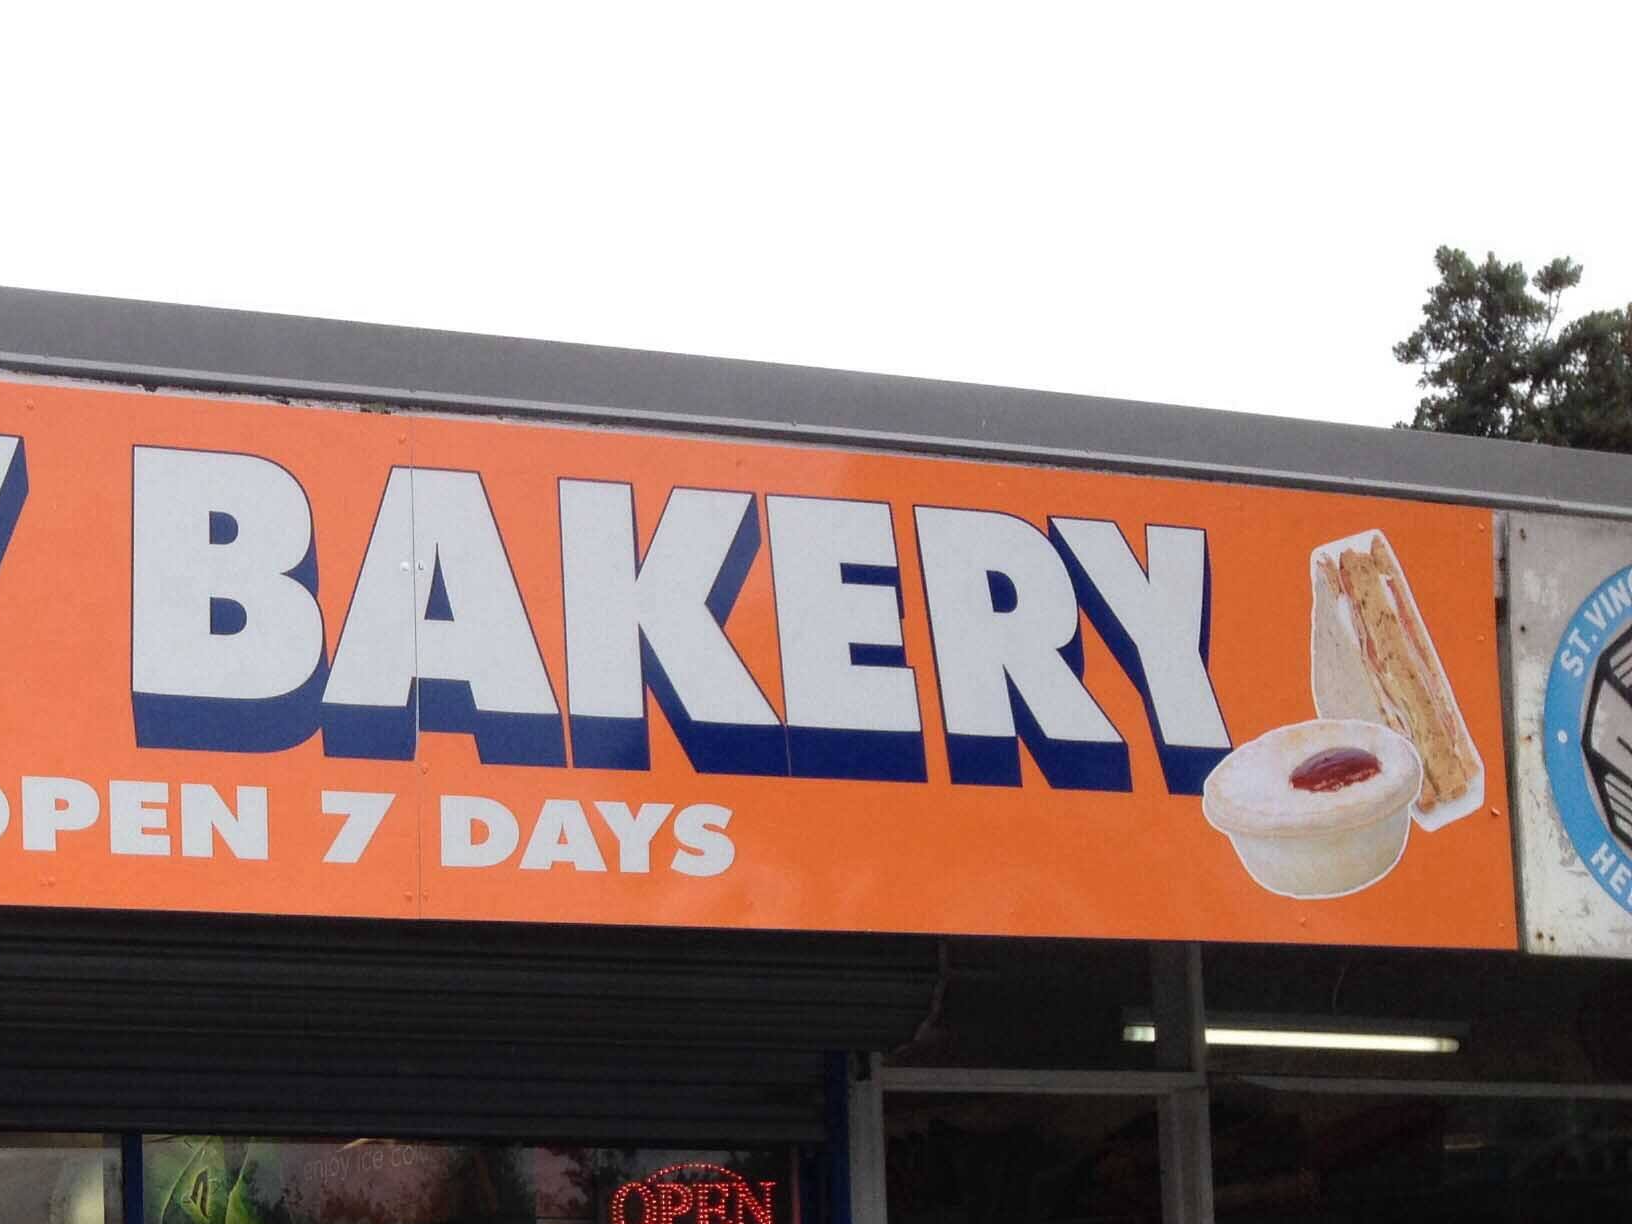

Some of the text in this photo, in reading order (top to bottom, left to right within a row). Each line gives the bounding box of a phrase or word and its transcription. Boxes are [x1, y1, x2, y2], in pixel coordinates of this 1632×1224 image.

[131, 445, 1234, 796] BAKERY
[320, 792, 397, 864] 7
[439, 793, 736, 877] DAYS
[1589, 842, 1632, 907] HE
